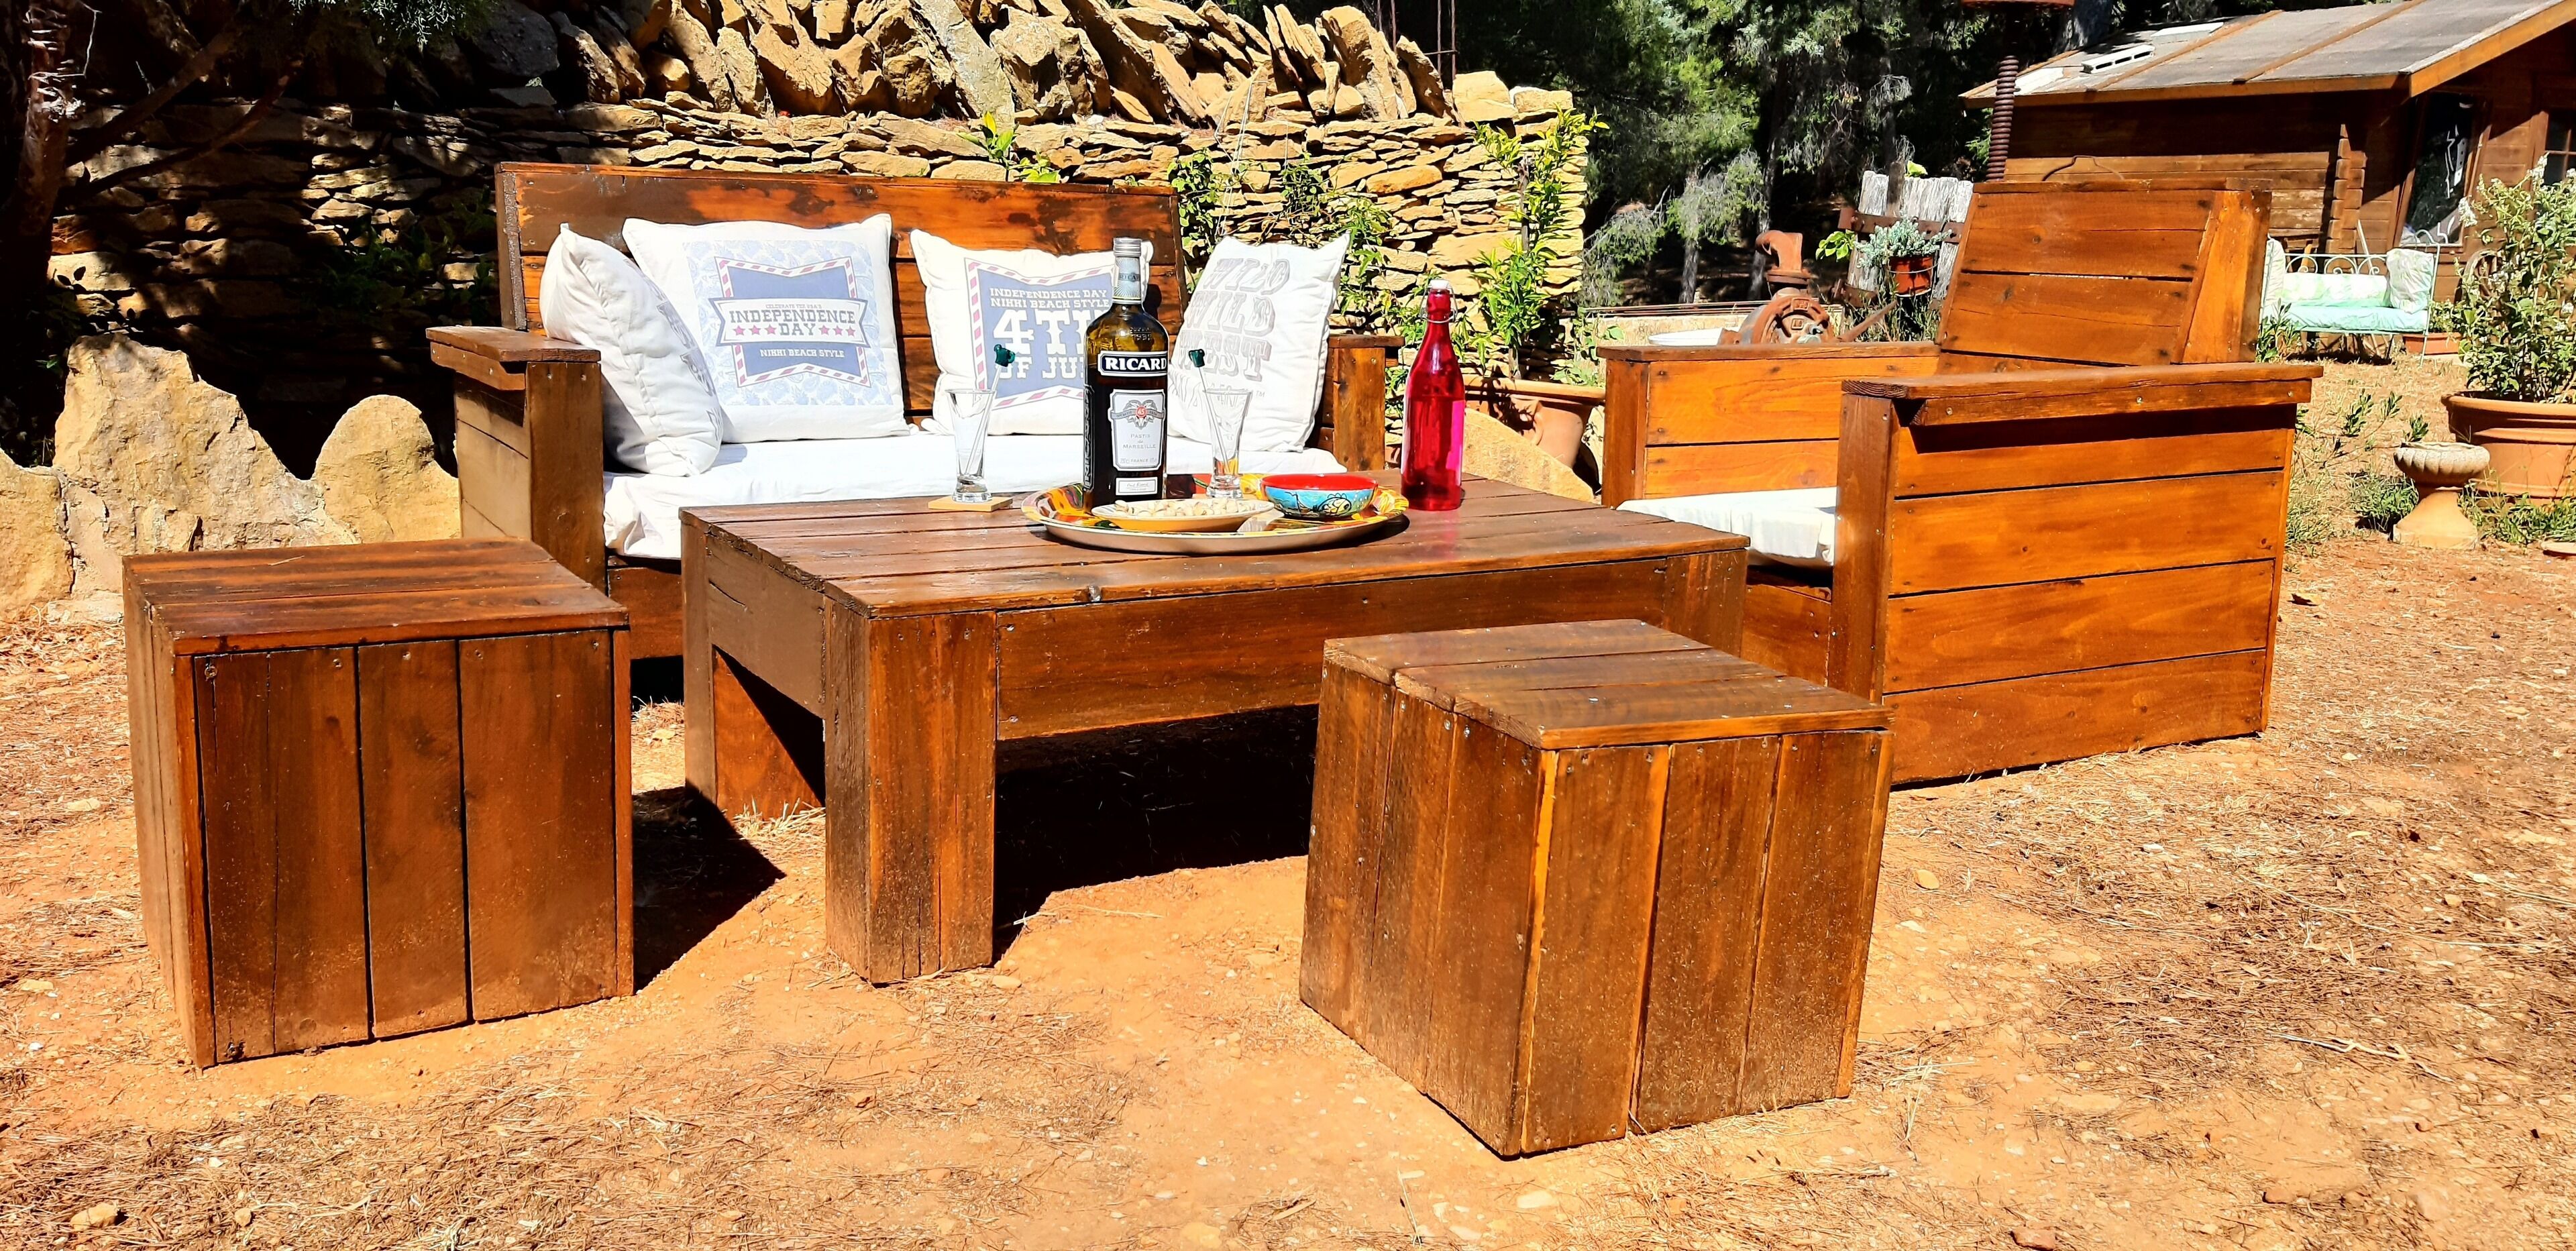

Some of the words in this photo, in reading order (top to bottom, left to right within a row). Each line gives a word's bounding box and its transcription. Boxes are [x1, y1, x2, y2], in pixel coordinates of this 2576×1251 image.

[1203, 258, 1290, 295] WILD
[989, 288, 1081, 299] INDEPENDENCE
[1082, 289, 1107, 298] DAY
[990, 298, 1027, 307] NIKKI
[1030, 300, 1071, 309] BEACH
[1073, 299, 1110, 308] STYLE
[729, 309, 856, 324] INDEPENDENCE
[1186, 290, 1275, 337] WILD
[778, 323, 816, 336] DAY
[759, 349, 787, 357] NIKKI
[789, 349, 817, 357] BEACH
[818, 349, 845, 358] STYLE
[1179, 329, 1272, 382] WEST
[1042, 357, 1084, 379] JU
[1104, 357, 1167, 371] RICARD
